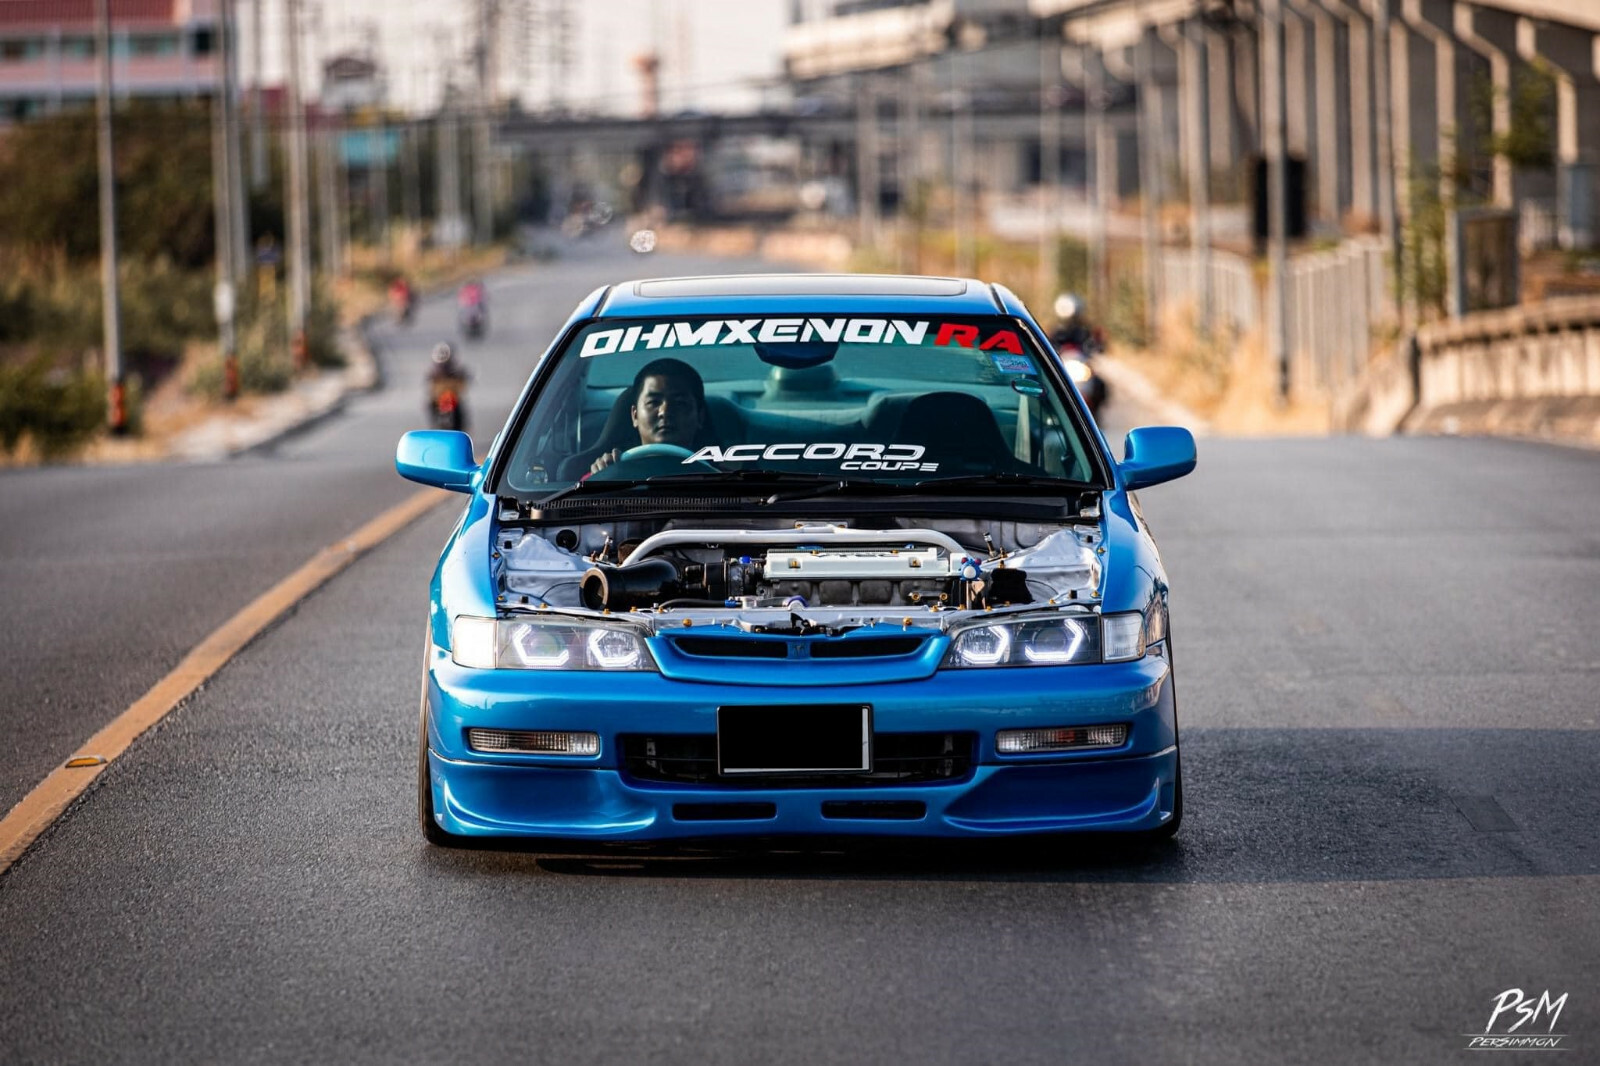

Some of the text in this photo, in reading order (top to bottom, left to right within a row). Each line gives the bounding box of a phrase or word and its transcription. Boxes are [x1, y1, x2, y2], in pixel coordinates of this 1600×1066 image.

[580, 318, 1024, 358] OHMXENON RA
[681, 443, 926, 464] ACCORD
[840, 461, 939, 471] COUPE
